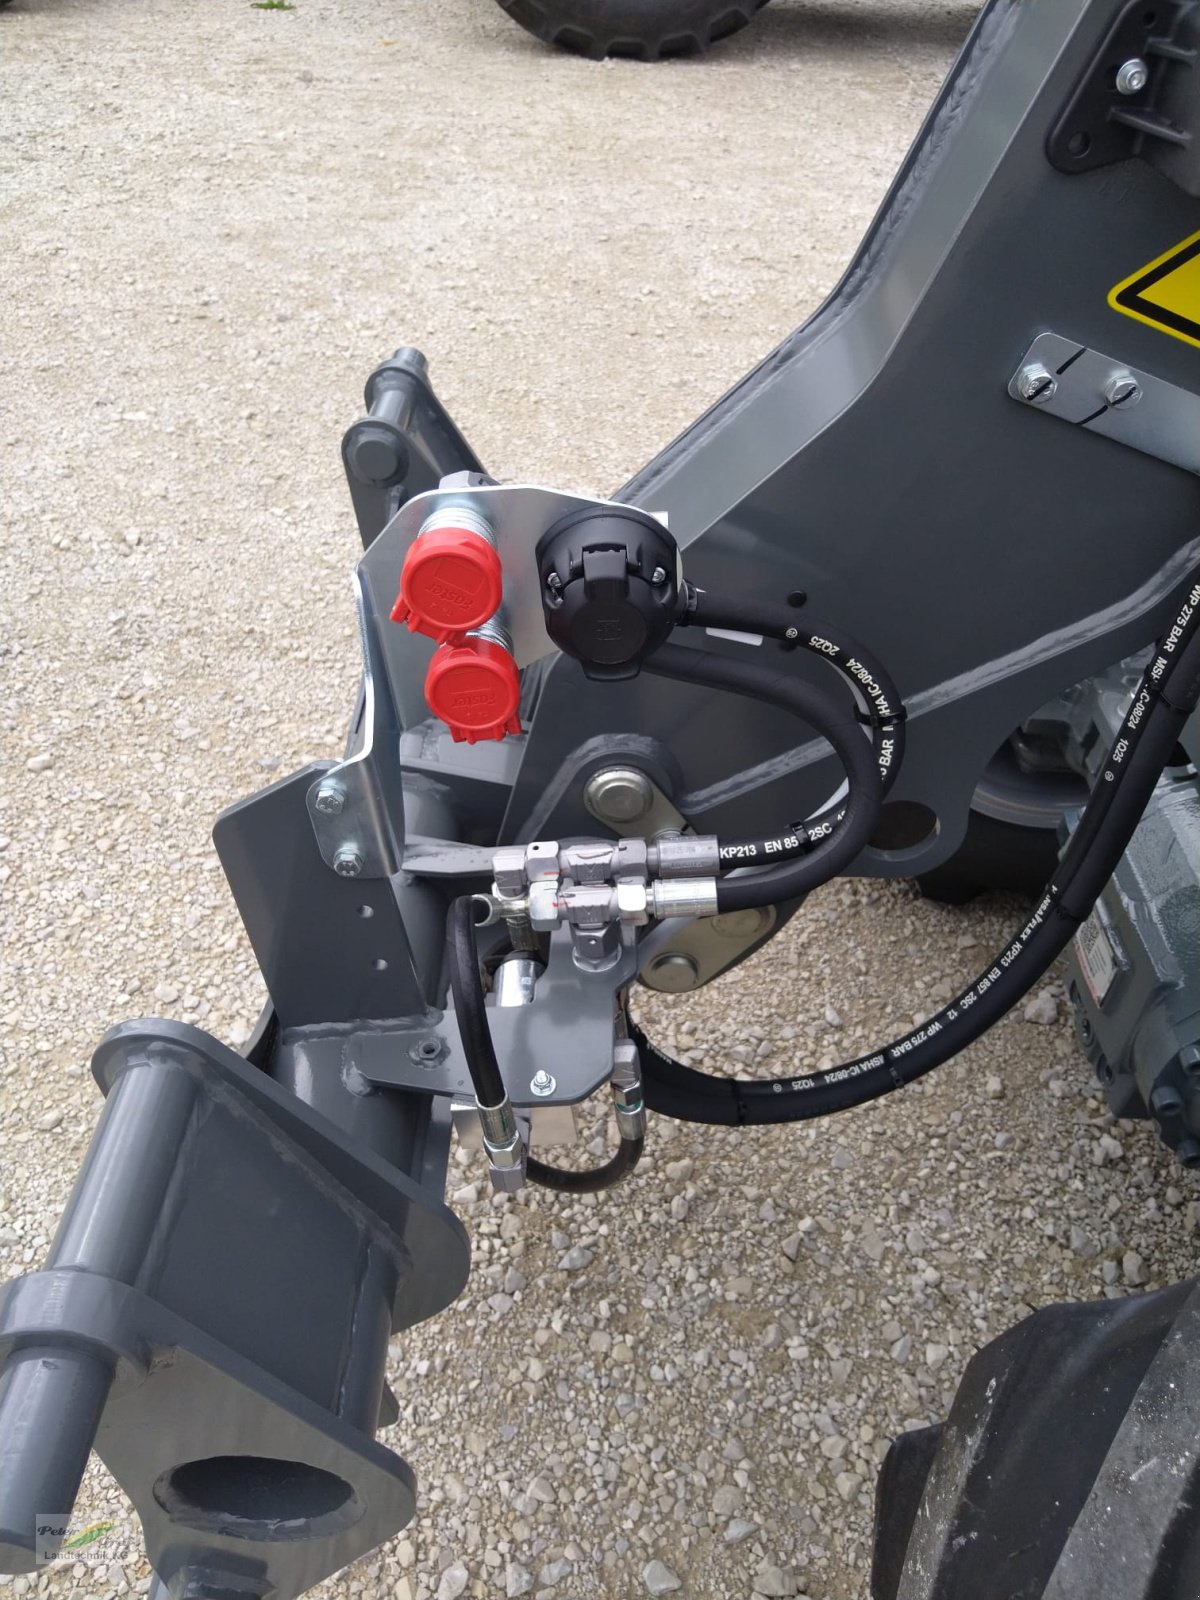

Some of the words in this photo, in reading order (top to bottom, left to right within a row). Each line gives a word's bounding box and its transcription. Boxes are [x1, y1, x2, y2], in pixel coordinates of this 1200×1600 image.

[1176, 604, 1193, 627] 275
[808, 635, 841, 656] 2Q25
[1163, 625, 1183, 652] BAR
[845, 658, 882, 697] IC-08/24
[878, 739, 895, 767] BAR
[1112, 737, 1129, 763] 1Q25
[720, 844, 757, 859] KP213
[764, 841, 783, 854] EN
[783, 836, 799, 849] 85
[808, 822, 833, 841] 2SC
[1000, 941, 1023, 967] KP213
[987, 966, 1002, 982] EN
[977, 978, 991, 994] 857
[960, 991, 978, 1009] 2SC
[946, 1008, 958, 1021] 12
[926, 1021, 943, 1036] WP
[911, 1031, 928, 1046] 275
[891, 1041, 913, 1057] BAR
[824, 1067, 860, 1084] IC-08/24
